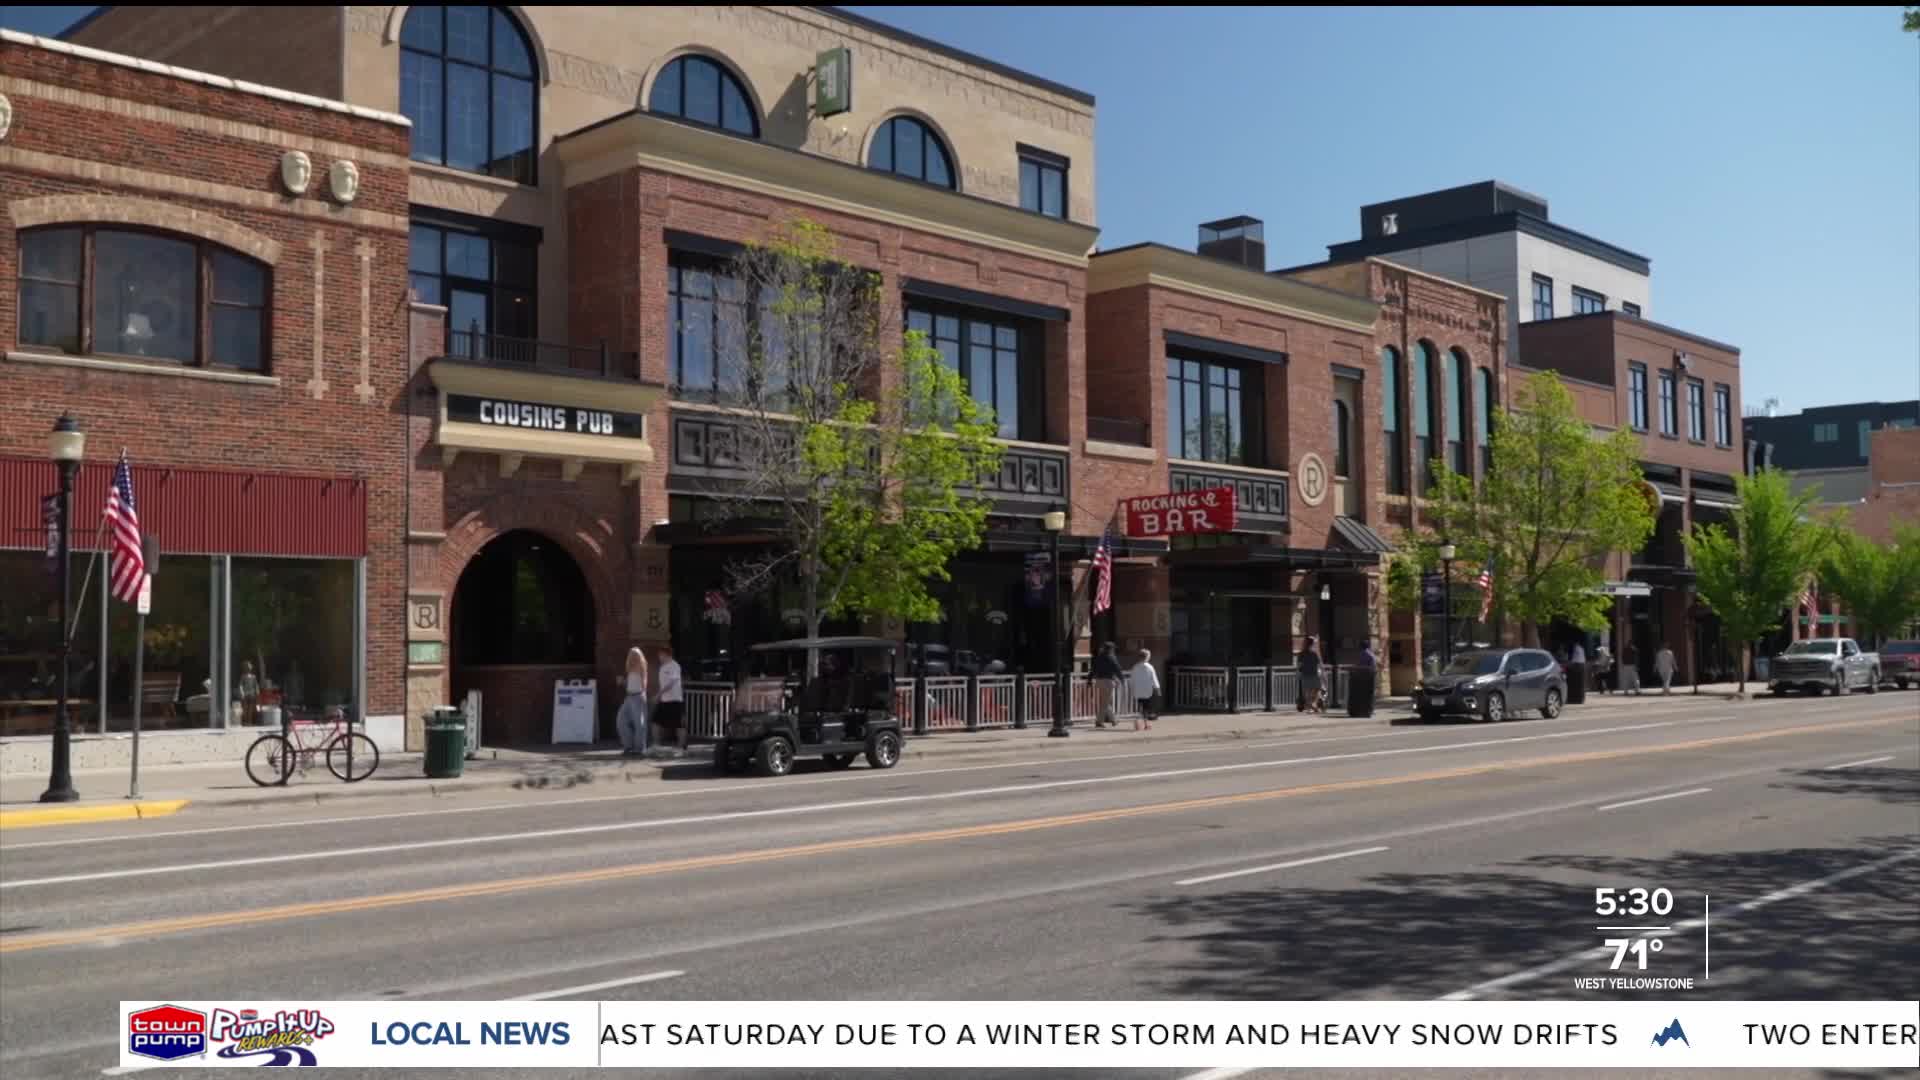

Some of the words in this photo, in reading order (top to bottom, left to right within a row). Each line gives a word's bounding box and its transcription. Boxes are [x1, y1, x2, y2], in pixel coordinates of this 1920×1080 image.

[480, 400, 566, 430] COUSINS
[576, 410, 613, 434] PUB
[1132, 494, 1198, 512] ROCKING
[1138, 508, 1216, 534] BAR
